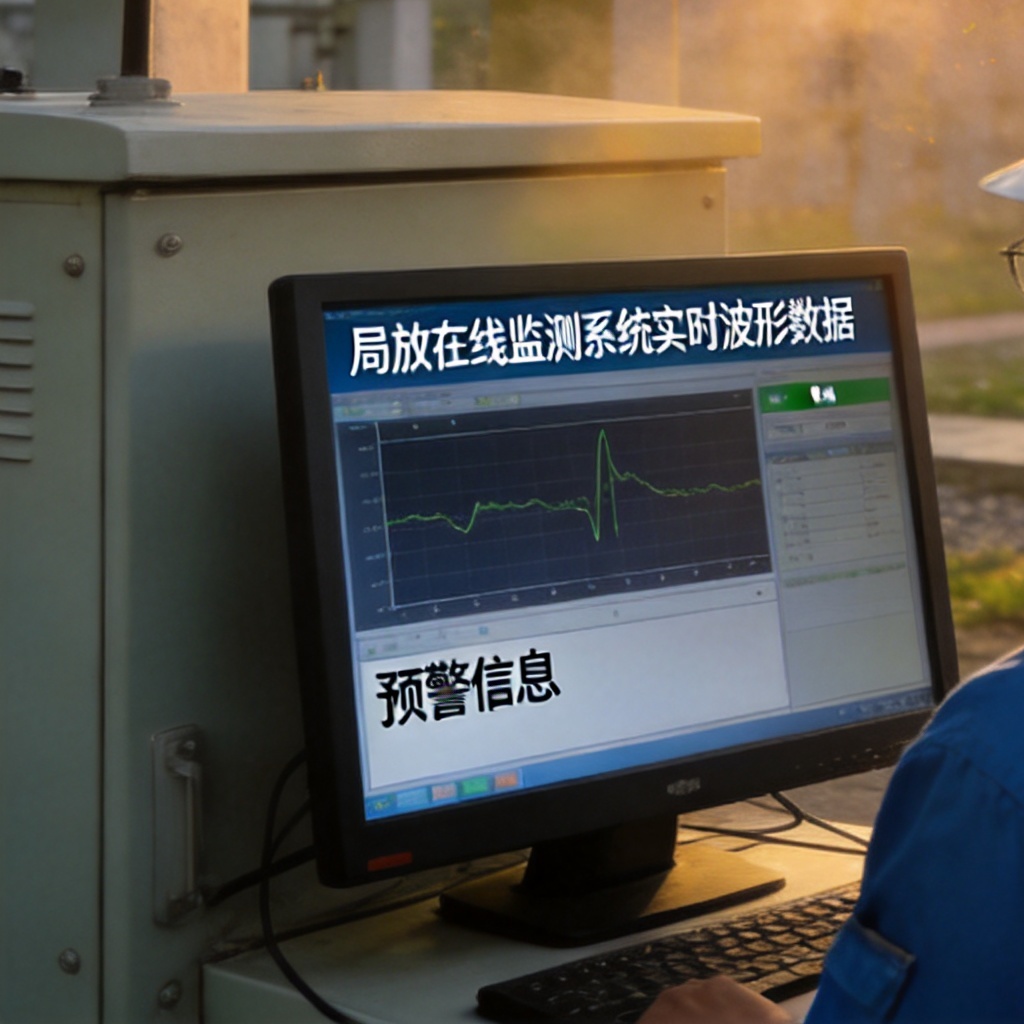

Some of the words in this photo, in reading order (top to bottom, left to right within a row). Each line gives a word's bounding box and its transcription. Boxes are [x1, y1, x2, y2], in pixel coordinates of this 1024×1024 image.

[350, 296, 855, 377] 局放在线监测系统实时波形数据
[375, 648, 562, 728] 预警信息
